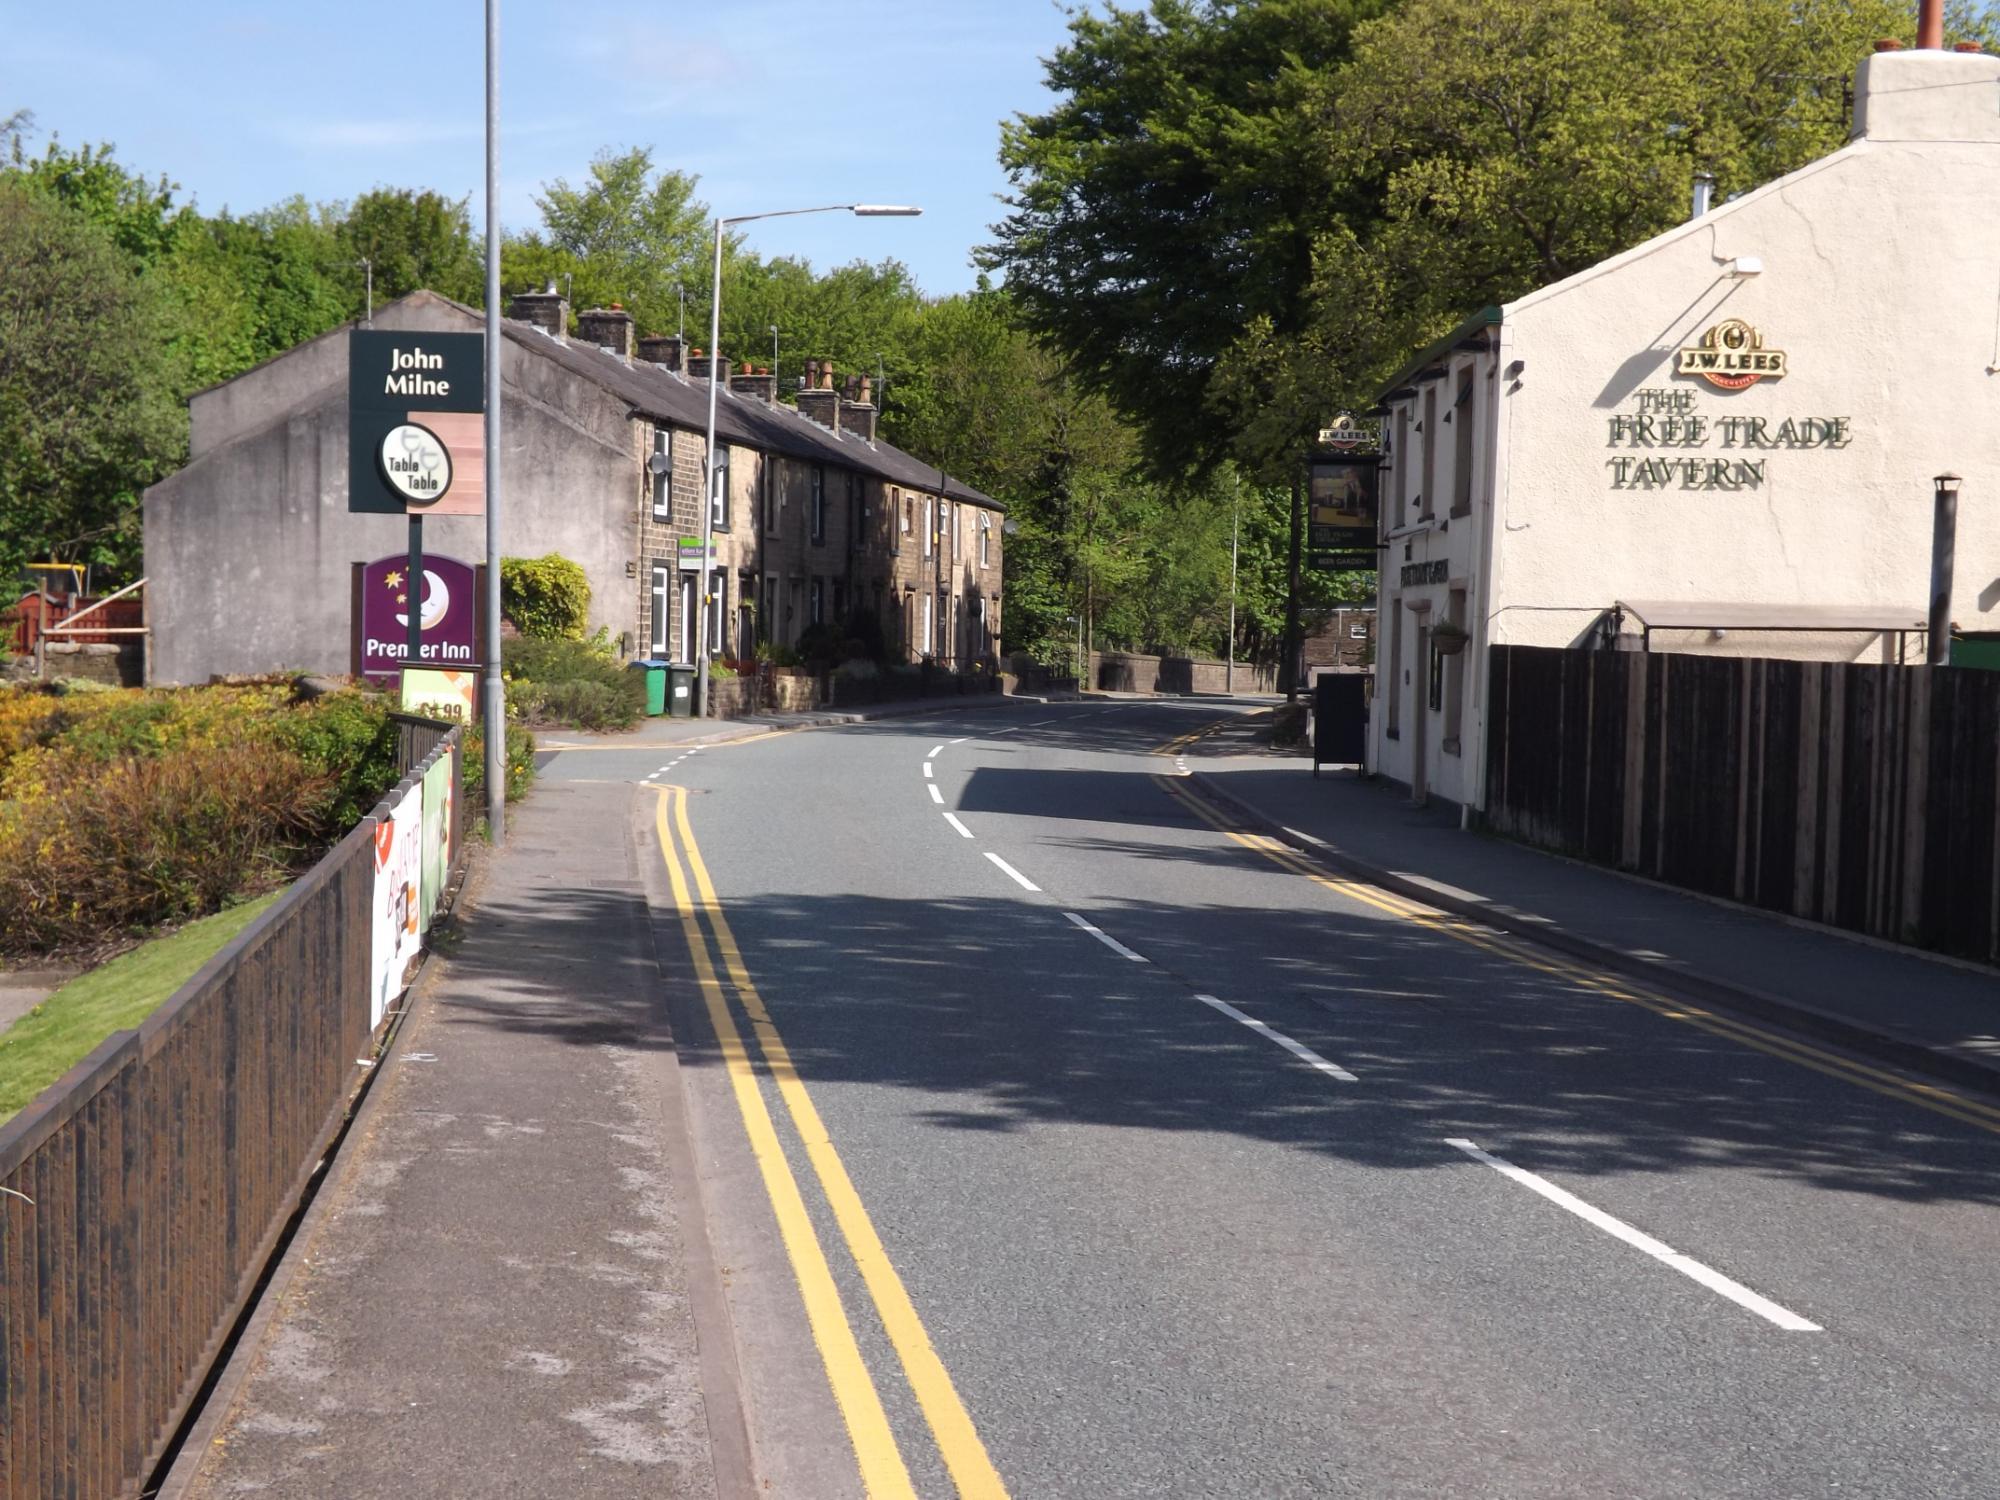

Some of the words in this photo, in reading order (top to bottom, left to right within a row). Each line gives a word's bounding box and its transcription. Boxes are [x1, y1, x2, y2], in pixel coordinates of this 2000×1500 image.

[392, 348, 443, 372] John
[384, 374, 450, 396] Milne
[1638, 388, 1697, 408] THE
[1613, 414, 1709, 441] FREE
[1721, 416, 1852, 443] TRADE
[389, 453, 419, 472] Table
[1611, 456, 1767, 484] TAVERN
[408, 471, 438, 490] Table
[366, 639, 439, 658] Premer
[442, 641, 470, 659] Inn
